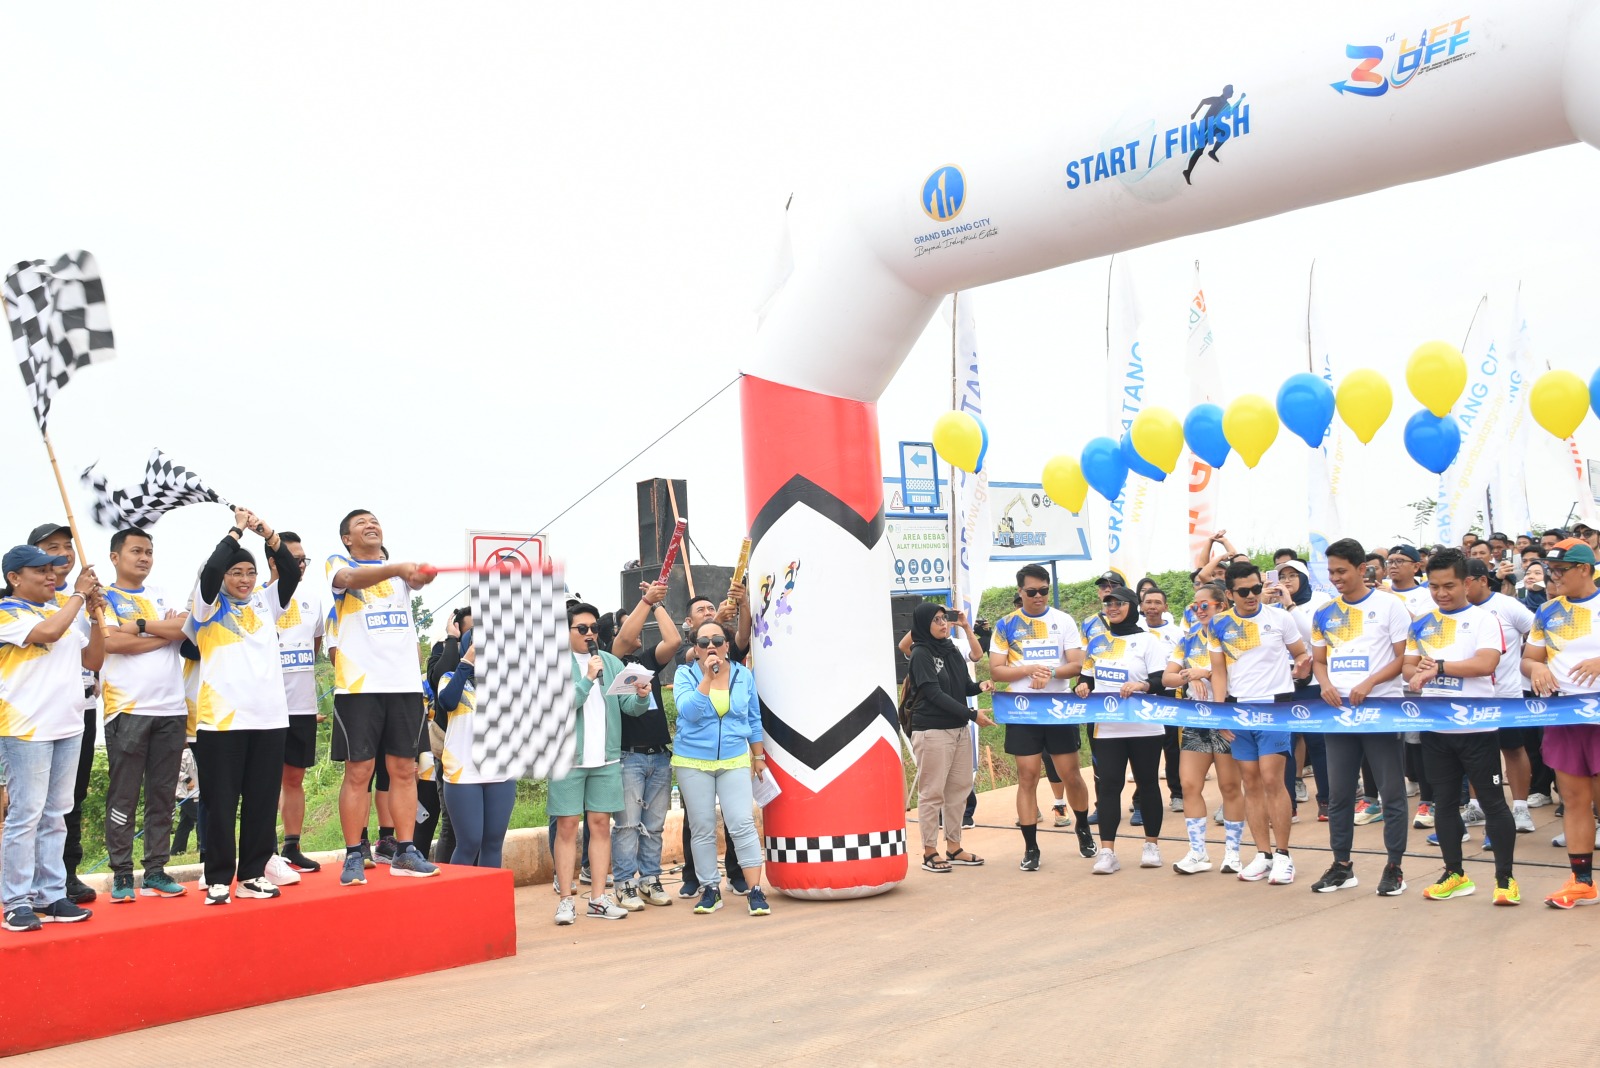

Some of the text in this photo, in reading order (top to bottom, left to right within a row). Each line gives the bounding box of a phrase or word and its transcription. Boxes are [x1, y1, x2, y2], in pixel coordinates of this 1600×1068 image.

[1397, 30, 1470, 75] OFF
[1066, 104, 1250, 189] START / FINISH
[913, 217, 991, 245] GRAND BATANG CITY
[903, 533, 945, 541] AREA BEBAS
[992, 532, 1046, 546] LAT BERAT
[367, 614, 407, 627] GBC 079
[298, 652, 313, 664] 064
[1026, 649, 1056, 658] PACER
[1332, 659, 1365, 669] PACER
[1097, 669, 1126, 680] PACER
[1425, 676, 1459, 687] ACER
